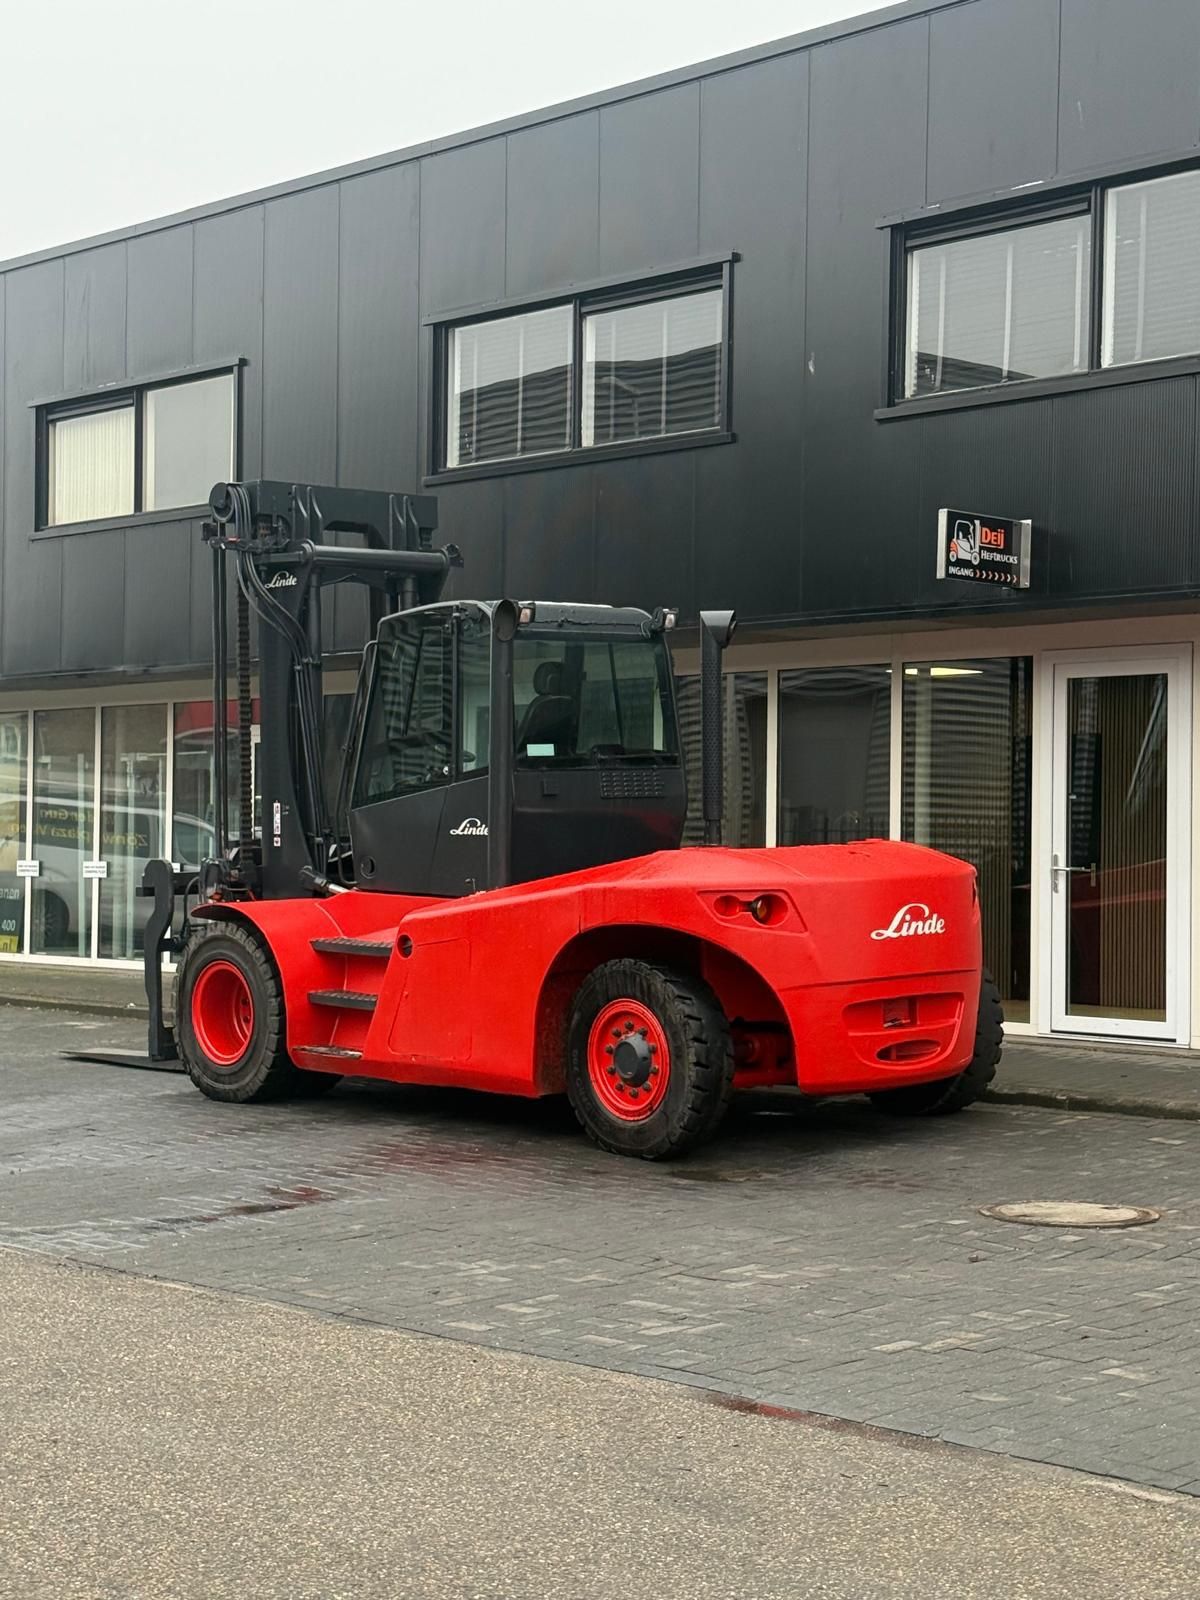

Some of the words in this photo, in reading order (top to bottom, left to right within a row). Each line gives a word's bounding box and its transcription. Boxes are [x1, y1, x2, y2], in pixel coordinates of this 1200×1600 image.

[264, 570, 298, 589] Linde
[948, 566, 974, 577] INGANG
[1, 919, 16, 932] 400
[870, 903, 946, 940] Linde
